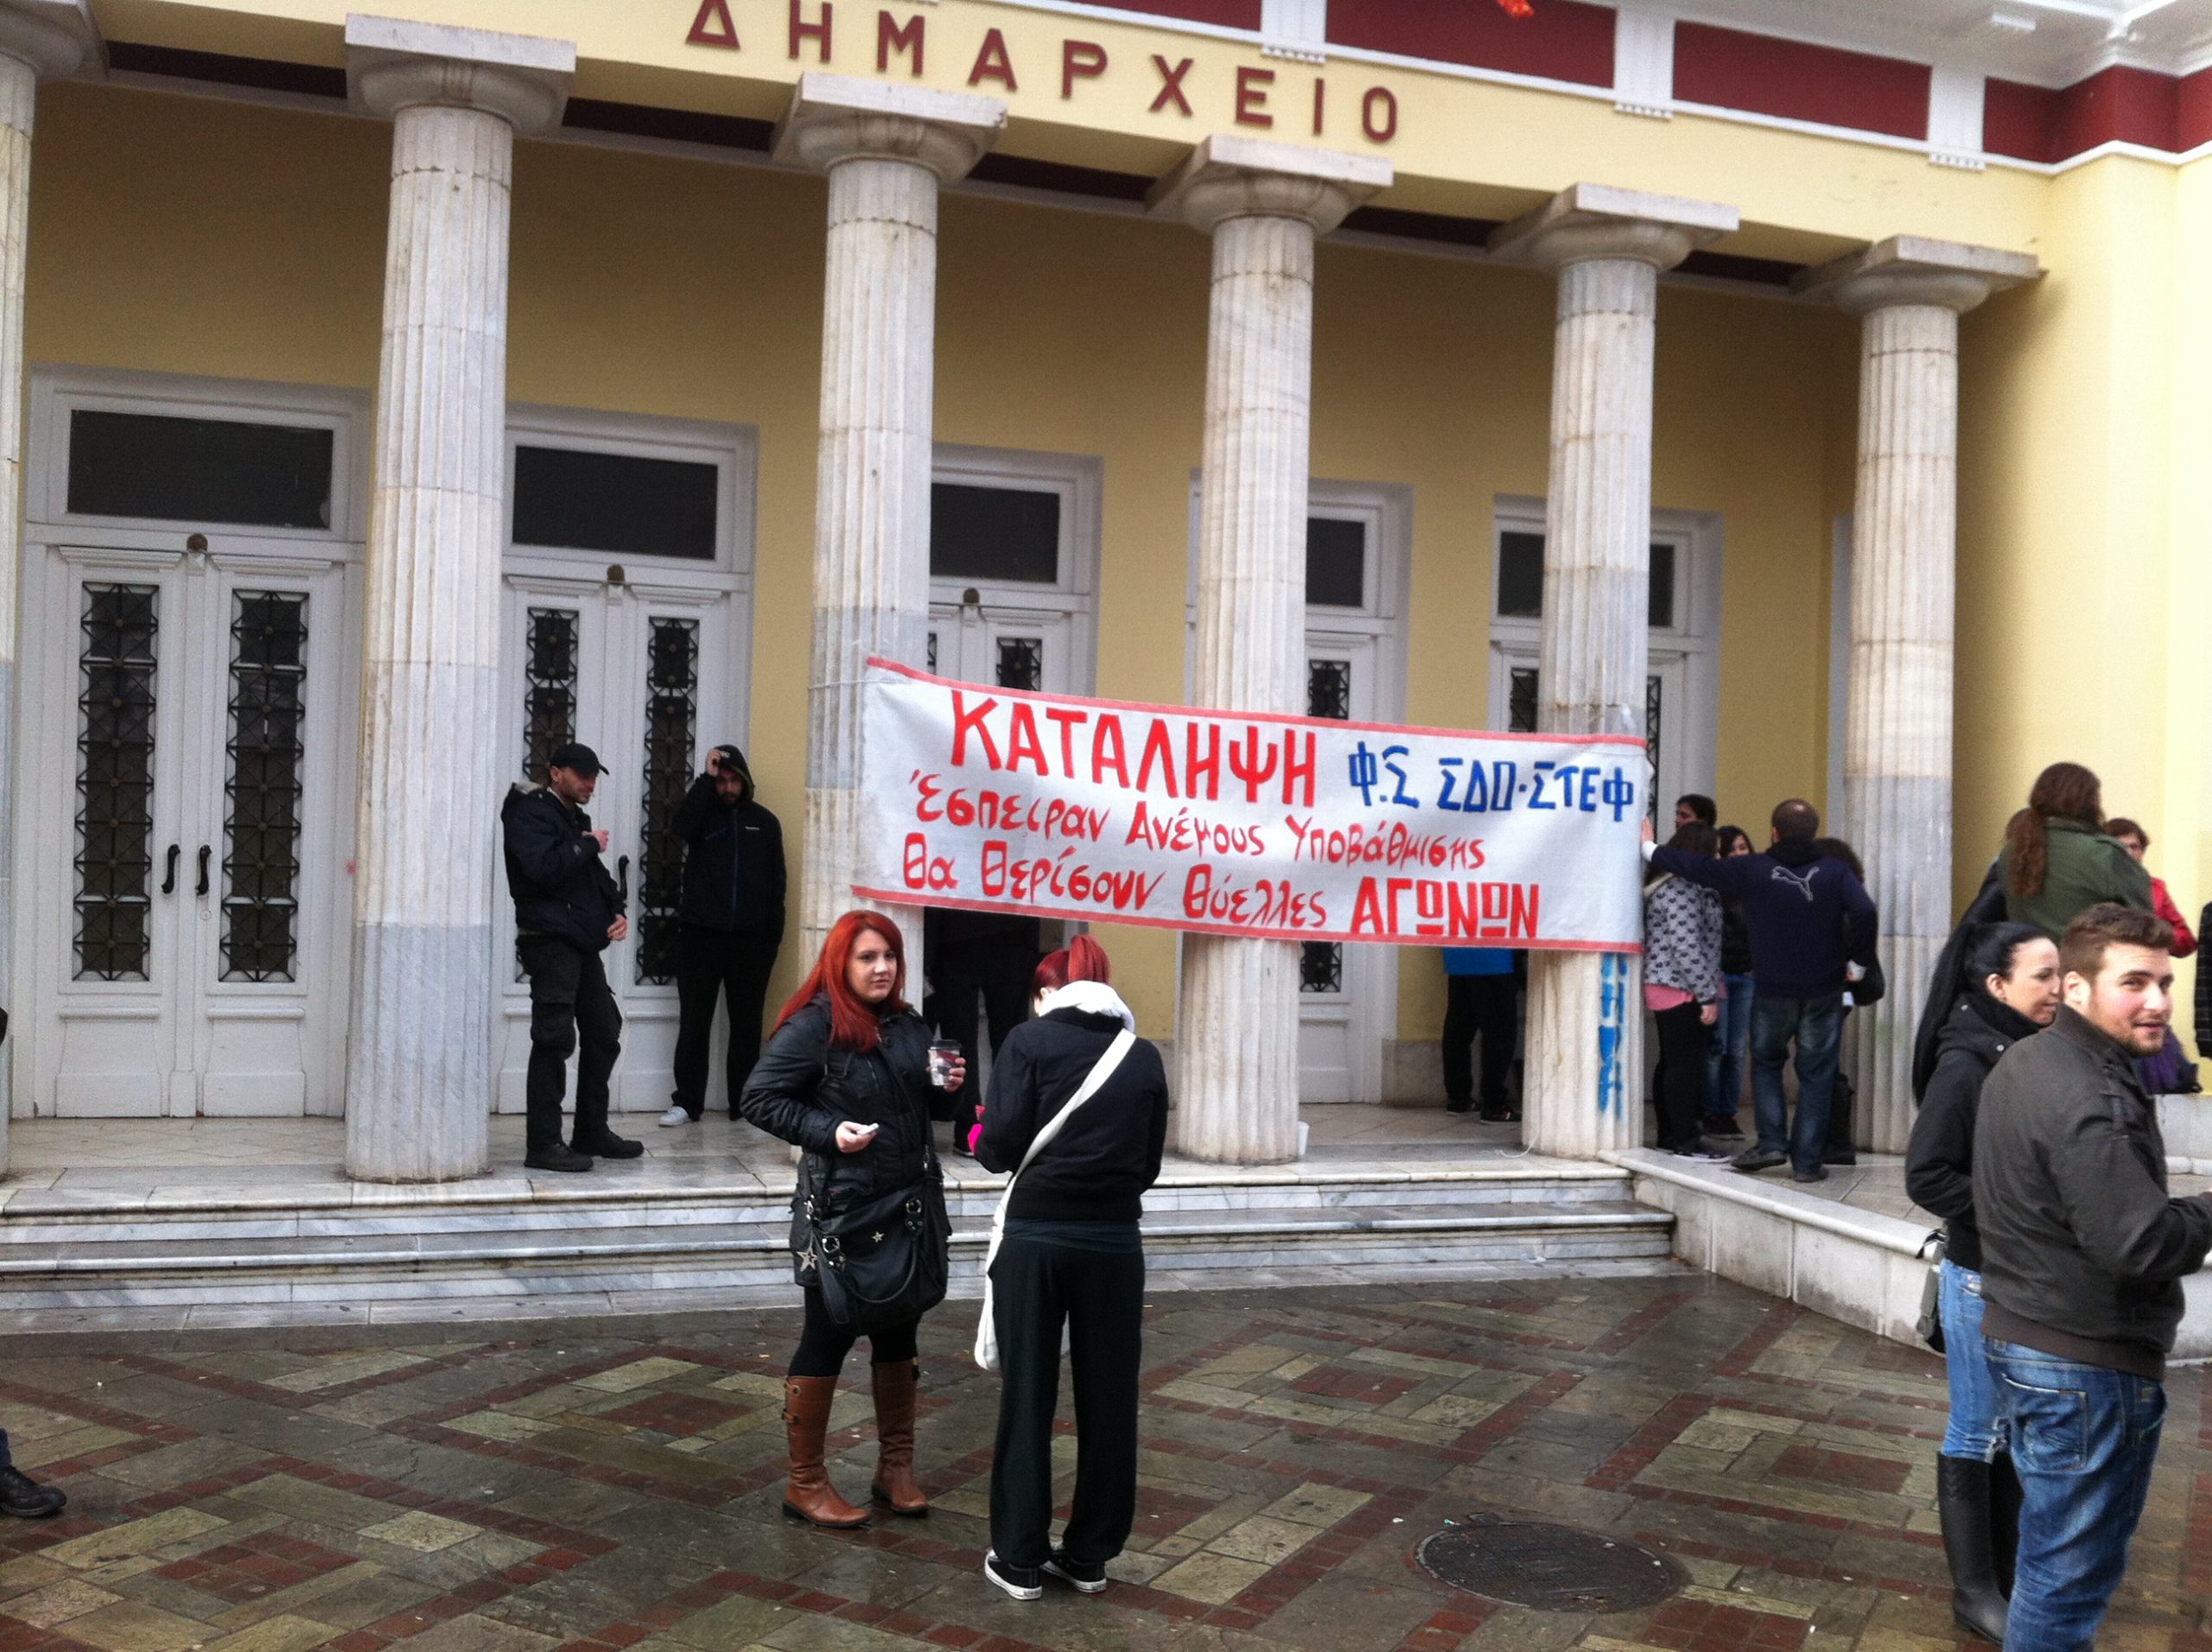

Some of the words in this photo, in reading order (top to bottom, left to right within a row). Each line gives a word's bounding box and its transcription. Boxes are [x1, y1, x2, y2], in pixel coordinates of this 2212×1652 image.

[686, 0, 1397, 143] ΔΗΜΑΡΧΕΙΟ
[950, 690, 1316, 808] ΚΑΤΑΛΗΨΗ
[909, 769, 1110, 842] Έσπειραν
[1124, 801, 1265, 858] Ανέμους
[1285, 814, 1486, 871] Υποβάθμισης
[1349, 875, 1540, 938] ΑΓΩΝΩΝ
